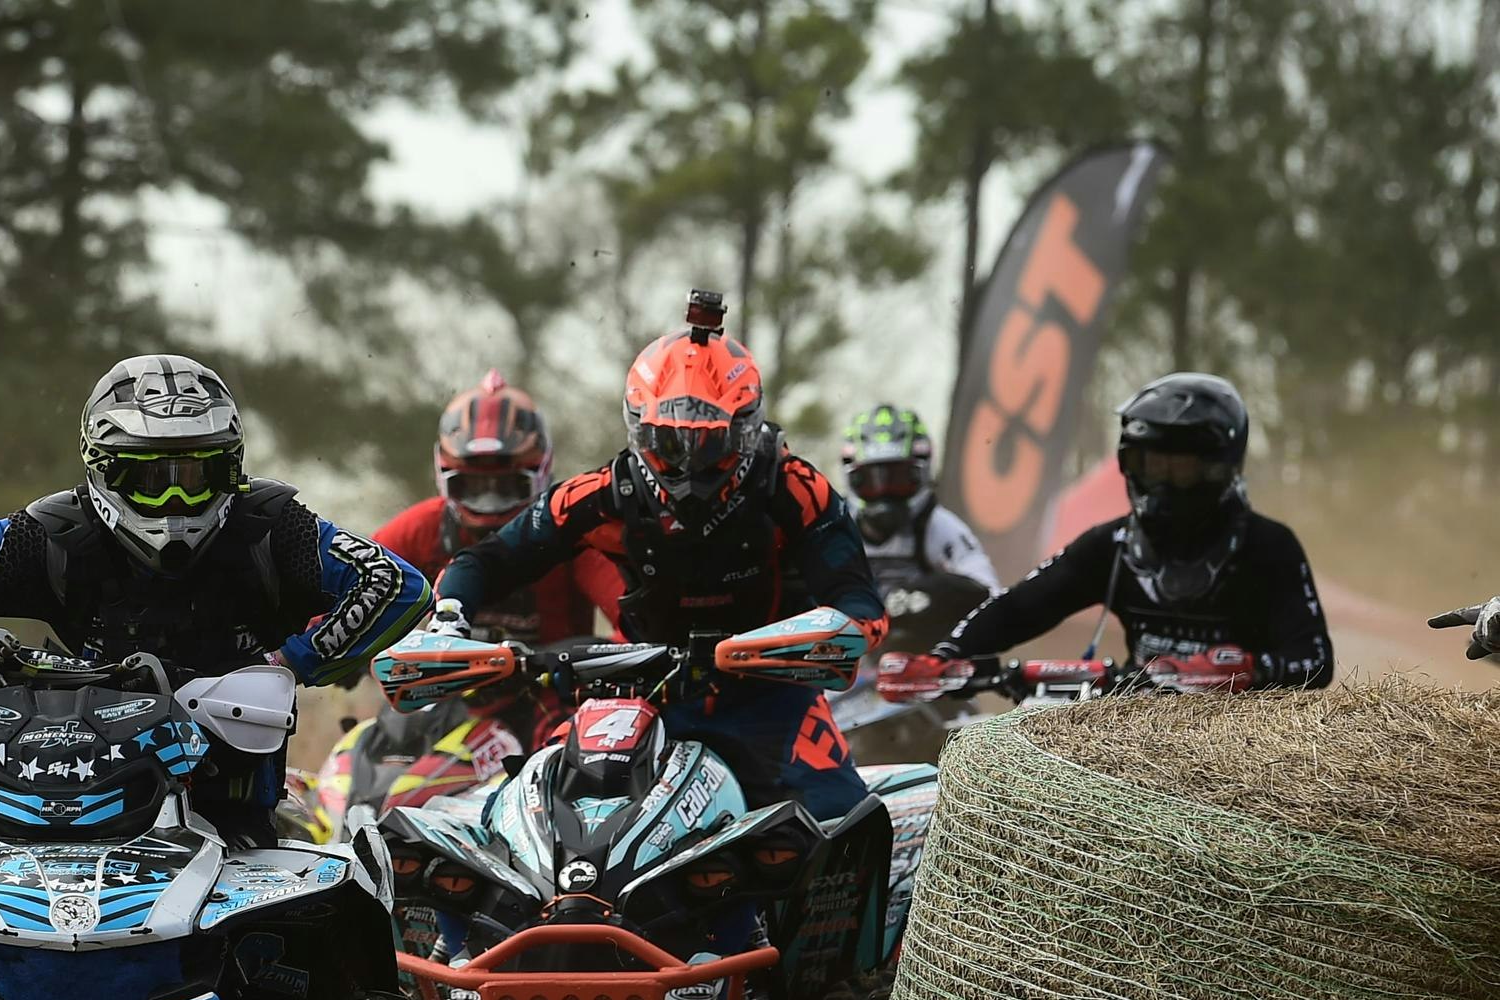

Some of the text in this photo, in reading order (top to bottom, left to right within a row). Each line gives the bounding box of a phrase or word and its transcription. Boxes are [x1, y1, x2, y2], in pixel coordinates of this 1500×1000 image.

[961, 193, 1106, 534] CST
[30, 650, 93, 668] flexx
[584, 709, 641, 740] 4
[22, 732, 94, 741] MOMENTUM
[584, 753, 631, 764] can-am
